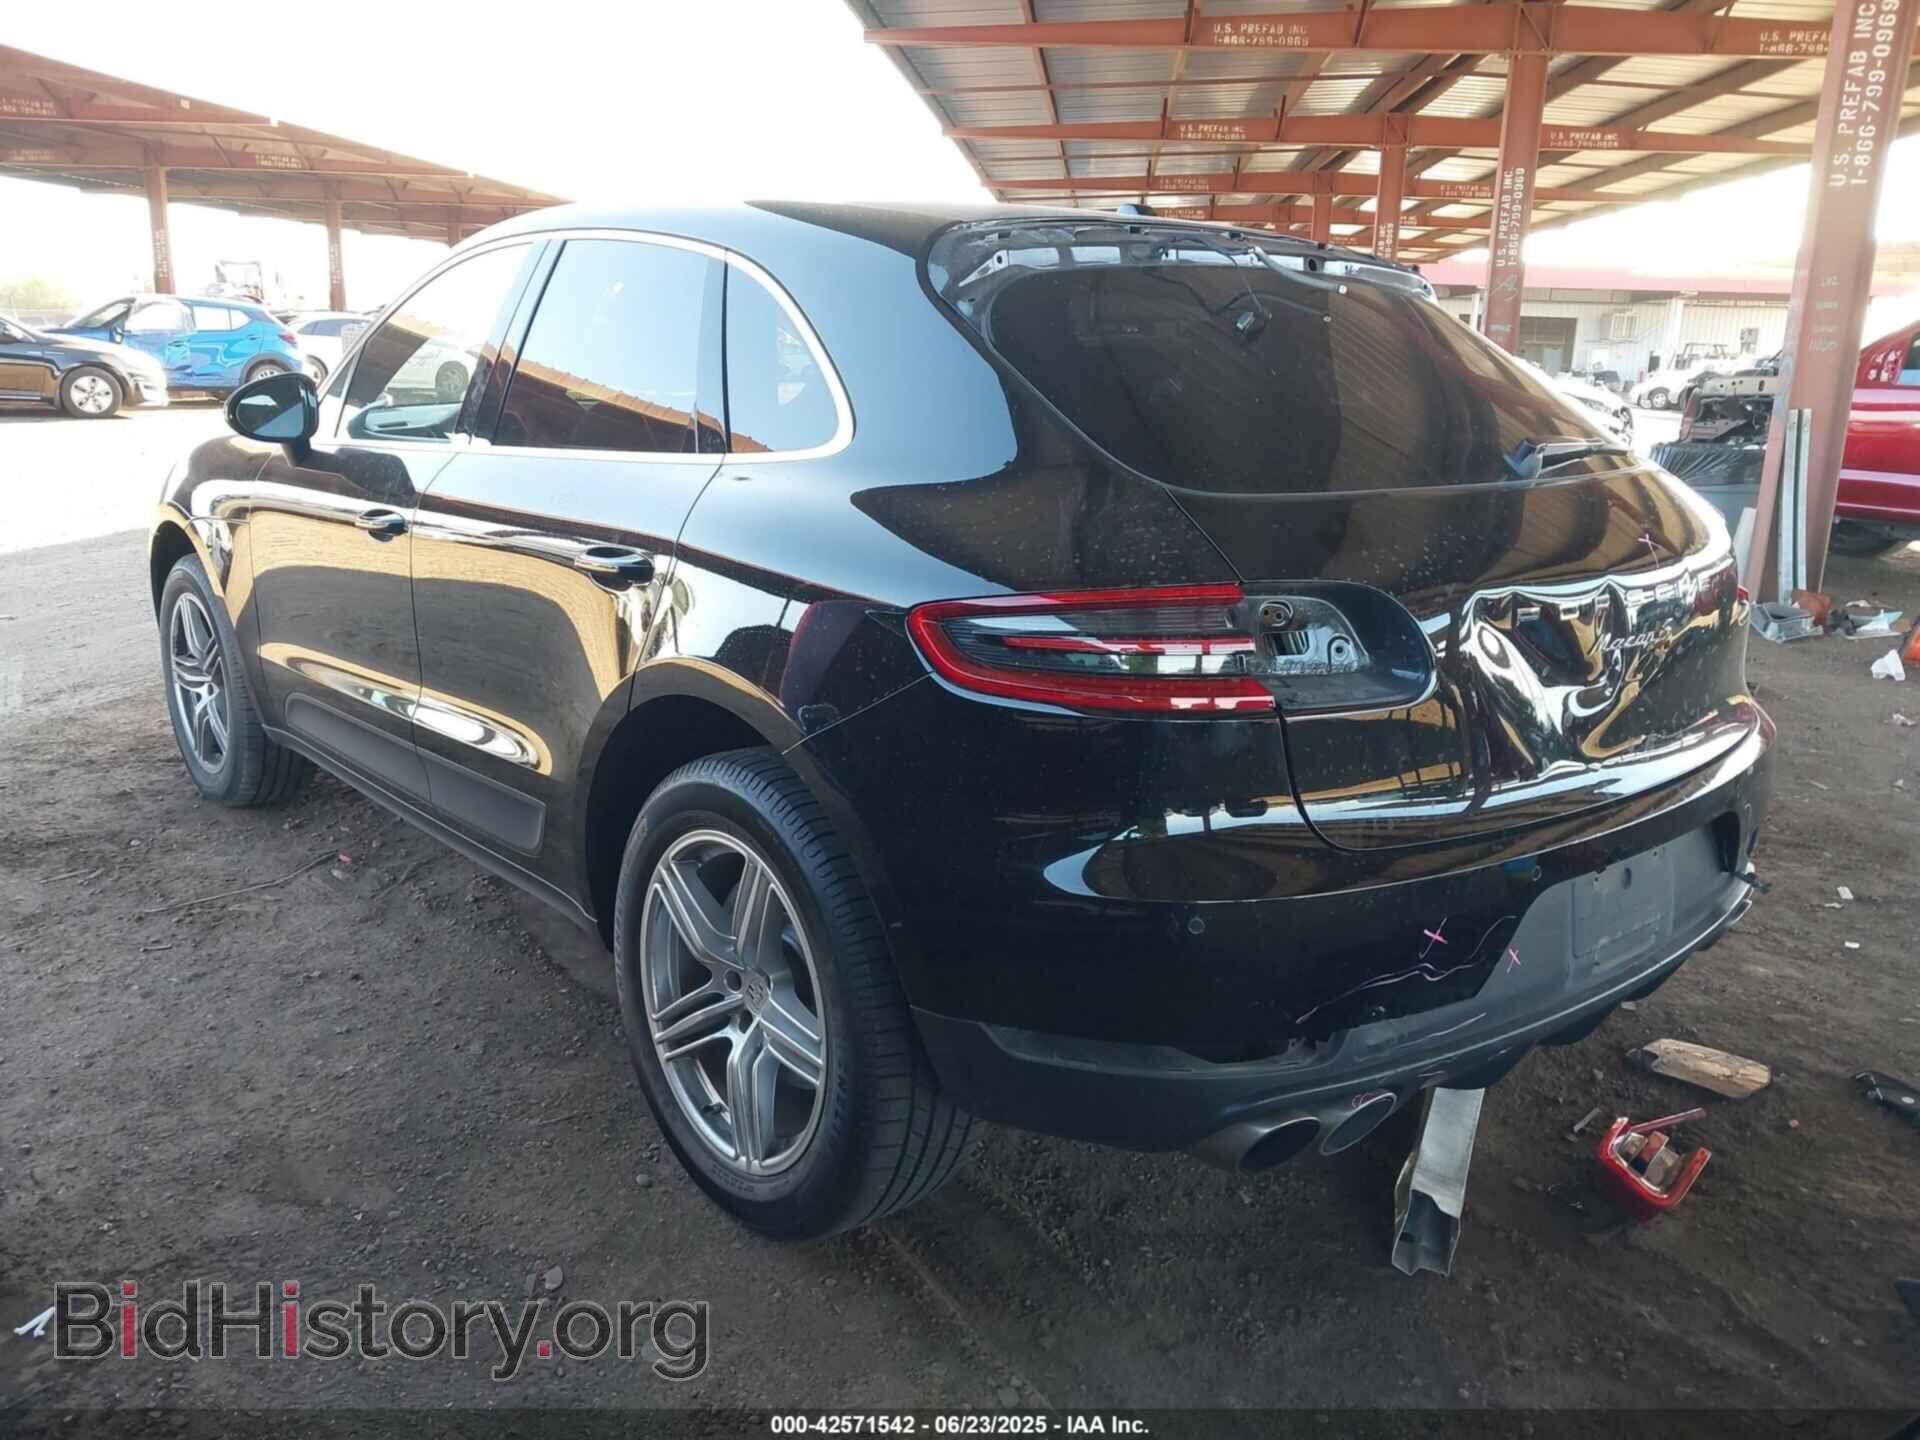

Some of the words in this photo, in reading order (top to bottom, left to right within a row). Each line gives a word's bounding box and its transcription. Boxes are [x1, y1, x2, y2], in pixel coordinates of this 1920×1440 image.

[1240, 23, 1284, 34] PREFAB
[1837, 50, 1868, 134] PREFAB
[1851, 0, 1900, 185] 1-866-799-0969
[1829, 147, 1852, 187] U.S.
[1498, 195, 1512, 239] PREFAB
